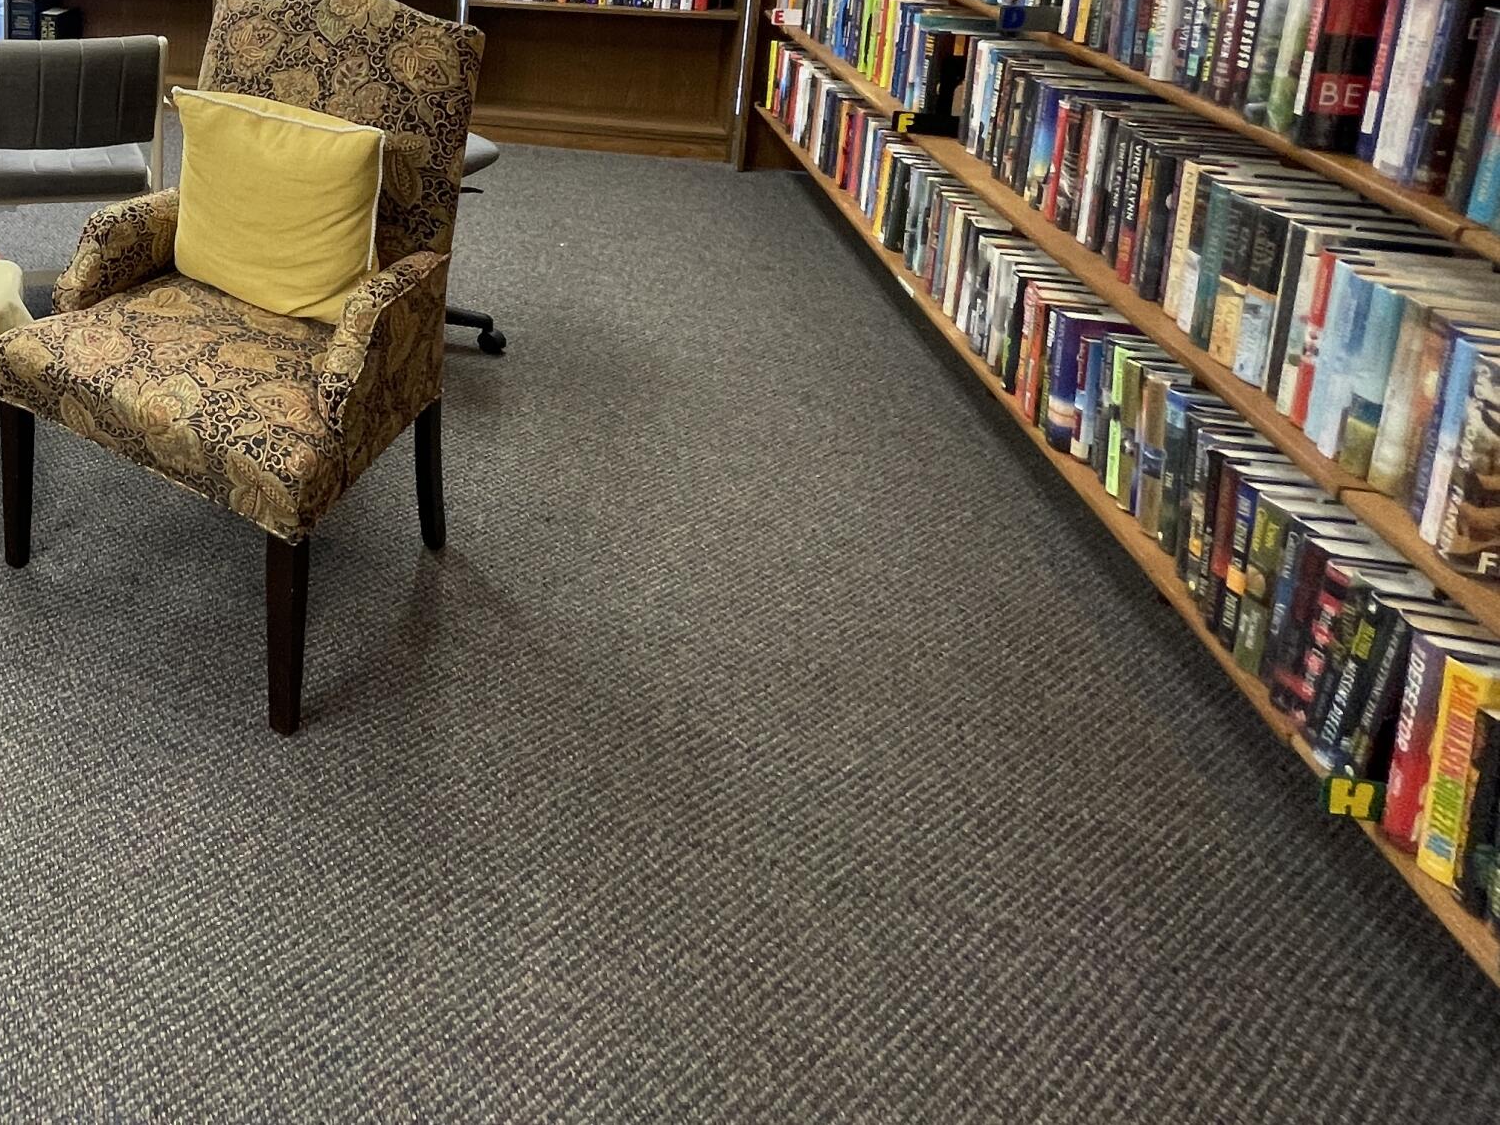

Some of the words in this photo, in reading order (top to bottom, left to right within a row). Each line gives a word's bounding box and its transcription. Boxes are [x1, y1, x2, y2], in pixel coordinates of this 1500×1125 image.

[774, 11, 785, 24] E
[1003, 6, 1026, 29] D
[1235, 19, 1256, 69] DEAVER
[897, 114, 915, 134] F
[1116, 141, 1127, 173] VINCE
[1130, 143, 1143, 181] VINCE
[1112, 174, 1122, 208] FLYNN
[1124, 182, 1136, 221] FLYNN
[1438, 484, 1465, 561] FRANZEN
[1333, 658, 1360, 704] MISSING
[1395, 652, 1425, 752] DEFECTOR
[1318, 702, 1344, 745] PIECES
[1329, 777, 1375, 818] H
[1428, 772, 1465, 842] SQUEEZE
